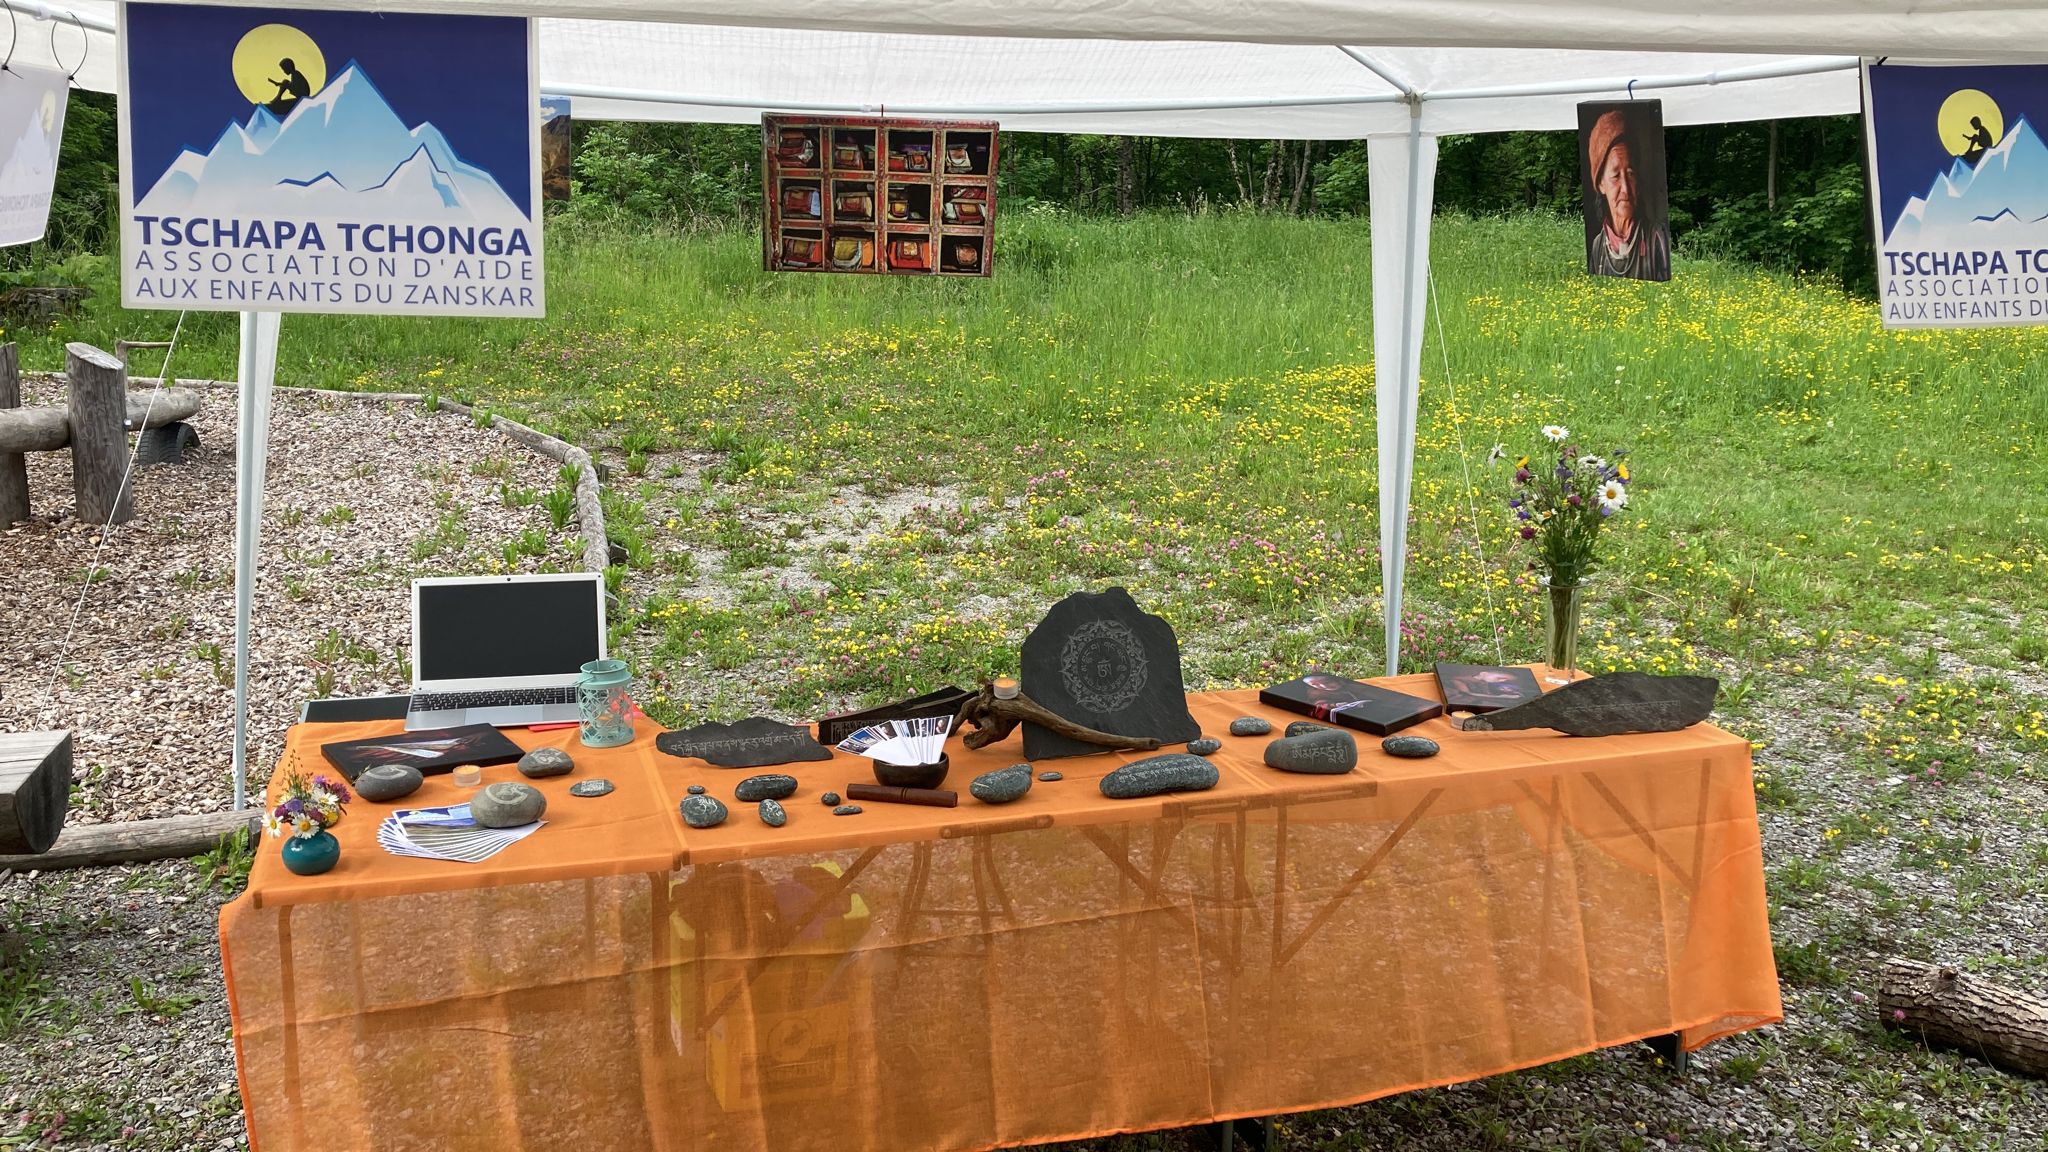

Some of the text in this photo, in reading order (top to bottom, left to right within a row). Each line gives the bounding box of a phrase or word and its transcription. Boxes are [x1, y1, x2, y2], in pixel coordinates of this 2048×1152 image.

[133, 215, 532, 257] TSCHAPA TCHONGA
[135, 249, 533, 281] ASSOCIATION D'AIDE
[1884, 250, 2008, 276] TSCHAPA
[136, 276, 535, 307] AUX ENFANTS DU ZANSKAR
[1887, 276, 2048, 297] ASSOCIATIO
[1889, 301, 1928, 320] AUX
[1933, 299, 2022, 320] ENFANTS
